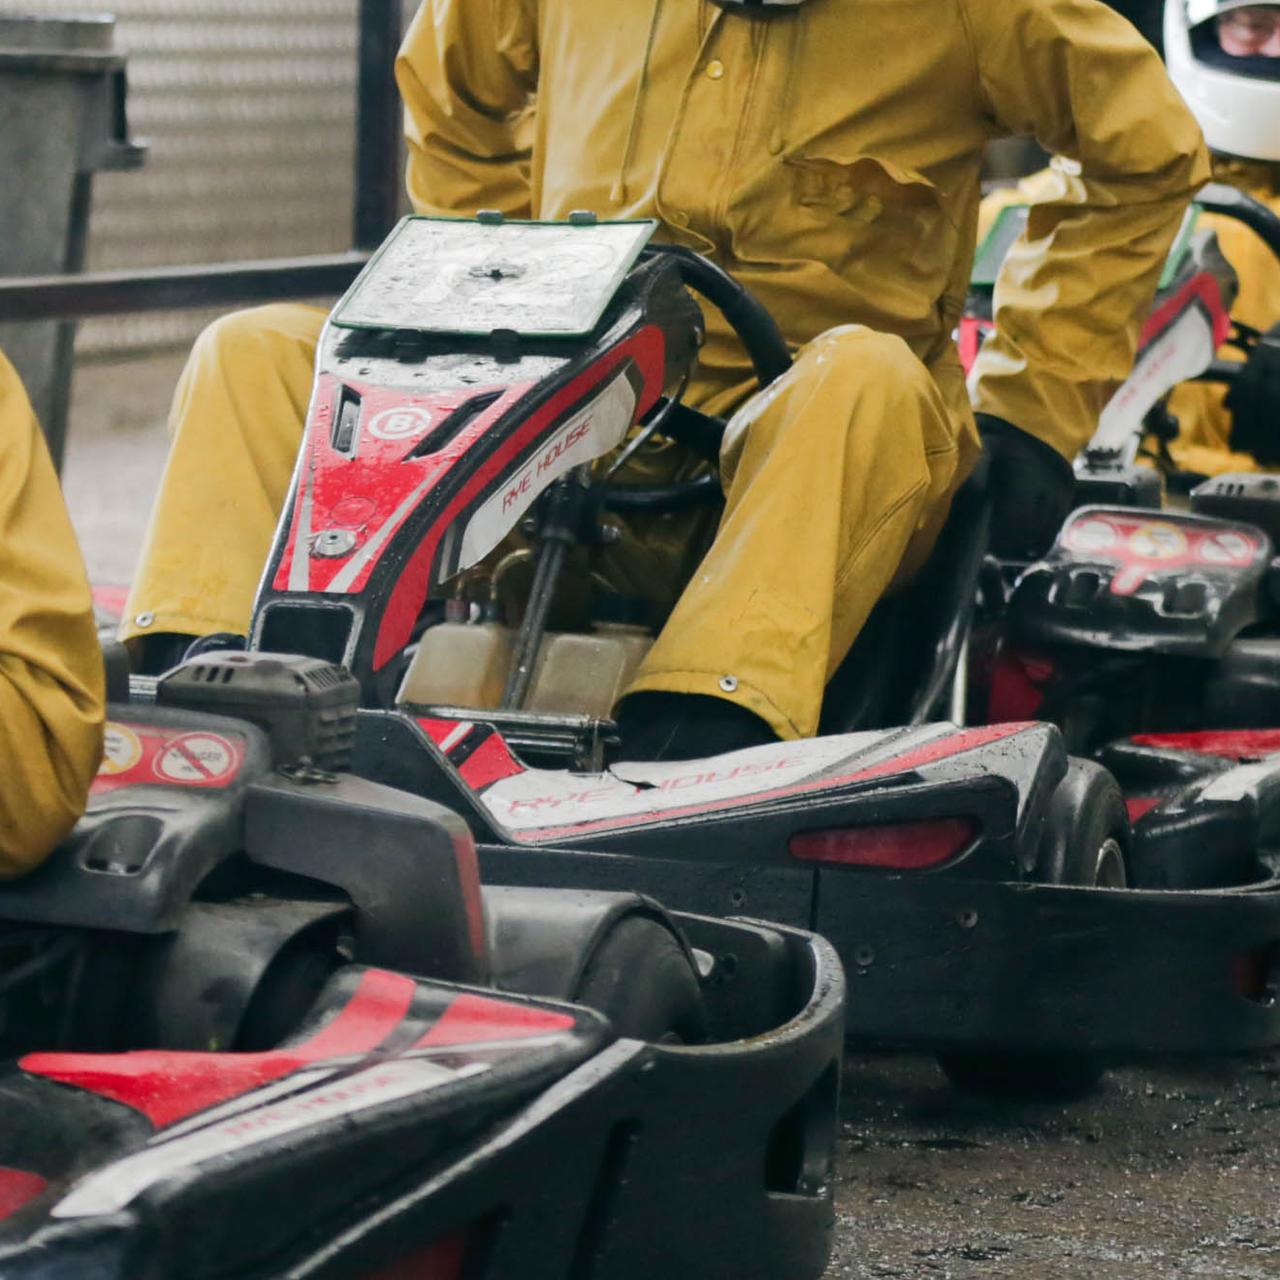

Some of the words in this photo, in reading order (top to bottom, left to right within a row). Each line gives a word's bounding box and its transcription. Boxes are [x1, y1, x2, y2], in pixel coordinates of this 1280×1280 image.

[502, 470, 532, 514] RYE
[536, 414, 594, 478] HOUSE
[507, 786, 615, 813] RYE
